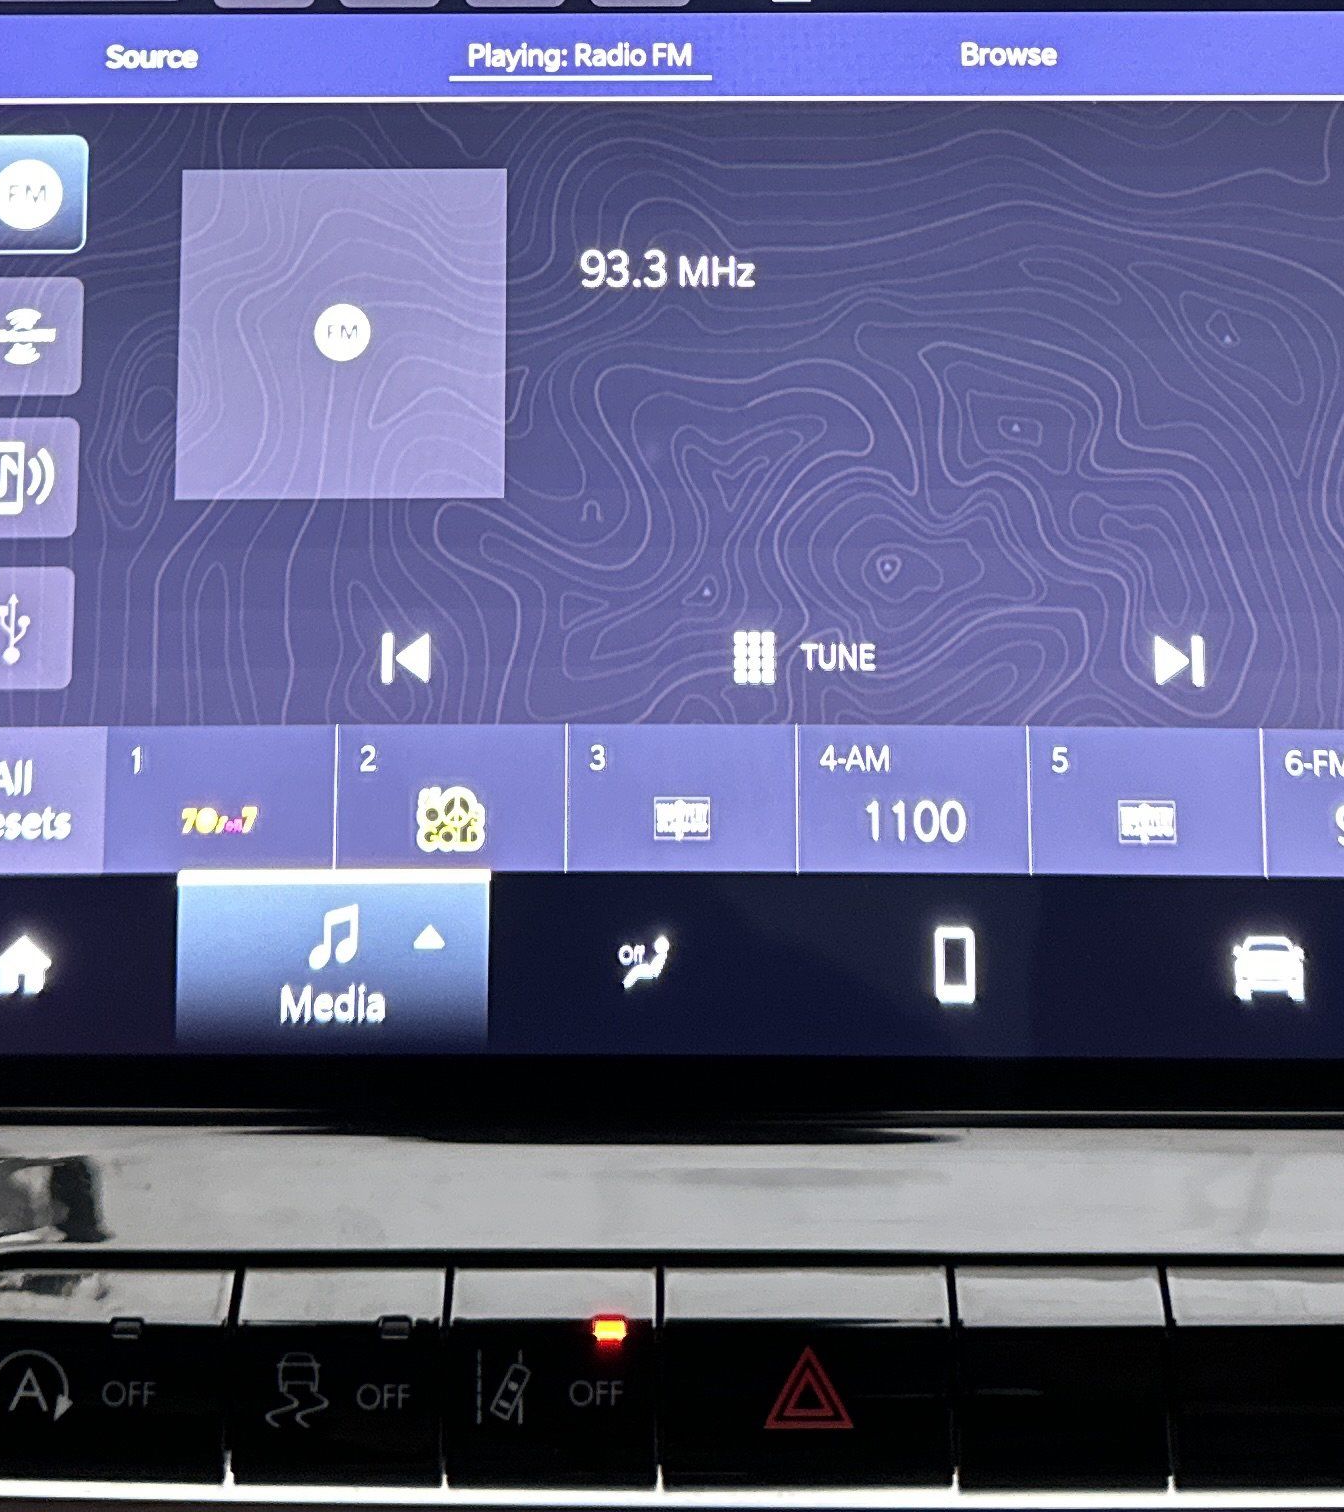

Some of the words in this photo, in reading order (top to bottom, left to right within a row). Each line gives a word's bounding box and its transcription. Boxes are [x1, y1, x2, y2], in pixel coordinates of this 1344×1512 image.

[105, 43, 199, 70] Source
[467, 42, 569, 73] Playing:
[574, 42, 647, 67] Radio
[652, 42, 692, 67] FM
[960, 41, 1058, 67] Browse
[8, 184, 47, 203] FM
[580, 248, 669, 289] 93.3
[678, 255, 756, 288] MHz
[327, 324, 358, 340] FM
[800, 643, 876, 672] TUNE
[130, 745, 143, 776] 1
[359, 744, 377, 774] 2
[589, 743, 607, 772] 3
[818, 745, 892, 774] 4-AM
[1051, 747, 1069, 775] 5
[863, 799, 968, 845] 1100
[279, 984, 387, 1025] Media
[101, 1380, 157, 1408] OFF
[355, 1384, 411, 1411] OFF
[569, 1380, 624, 1407] OFF
